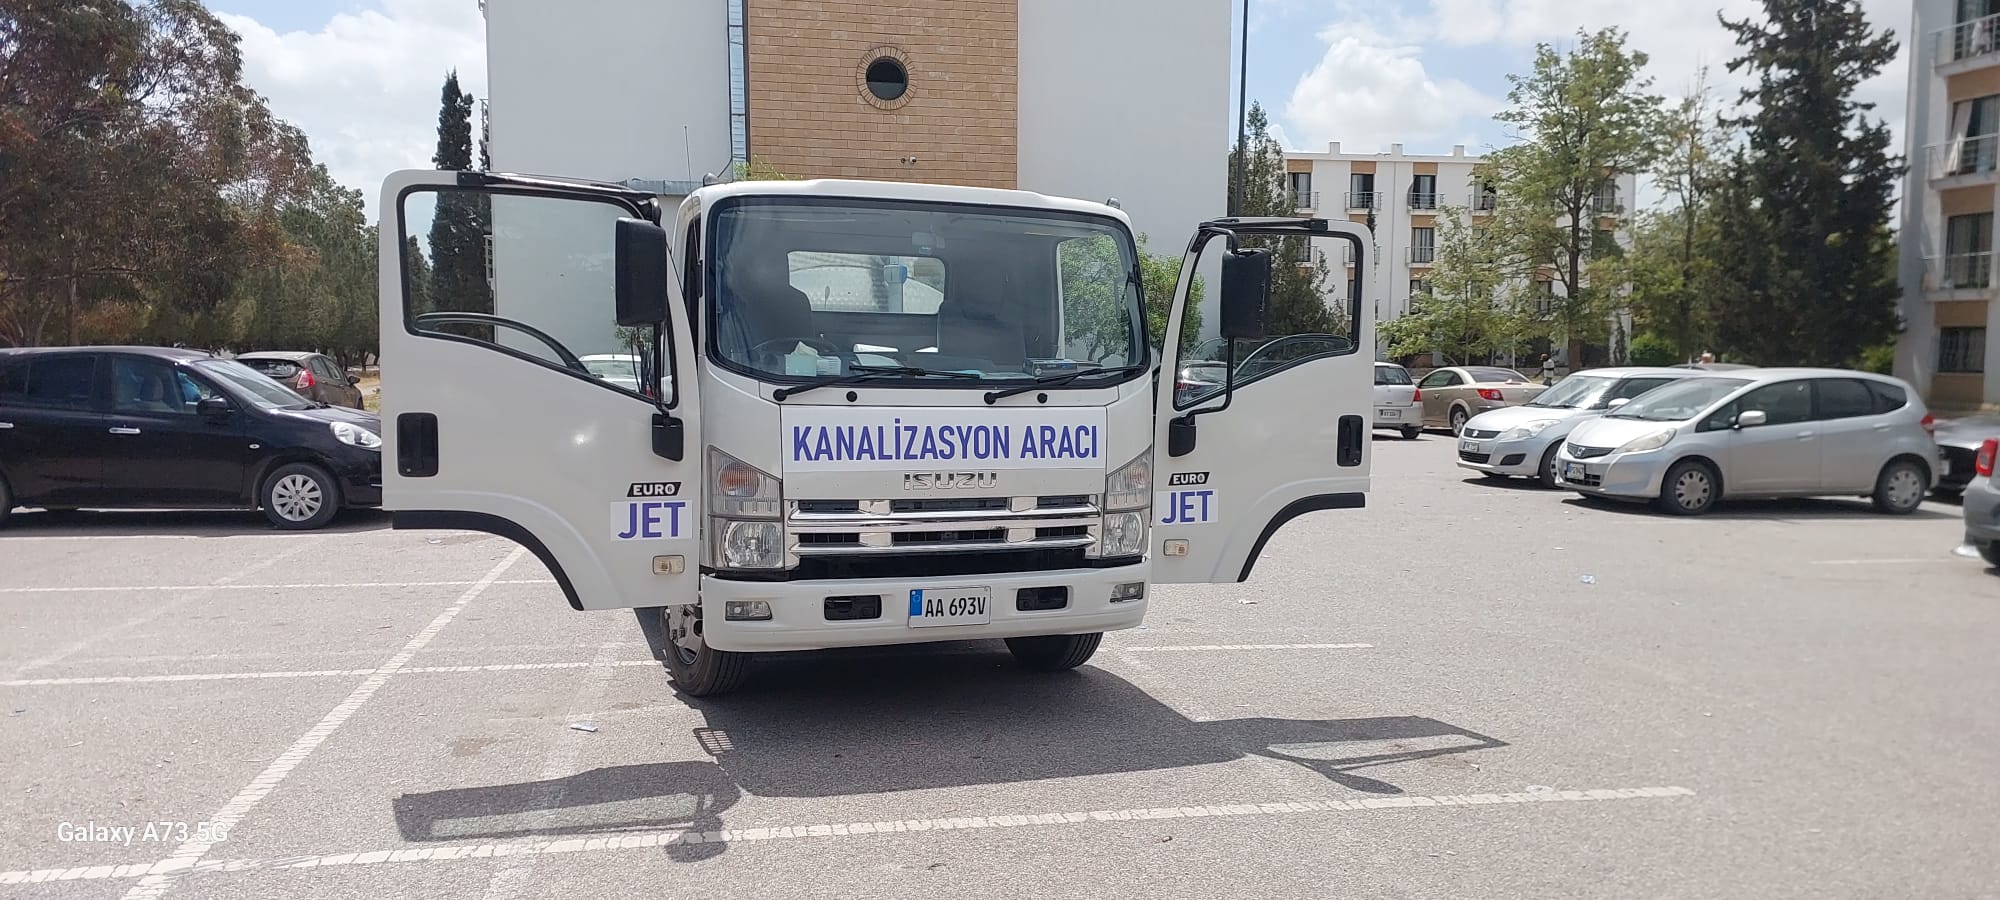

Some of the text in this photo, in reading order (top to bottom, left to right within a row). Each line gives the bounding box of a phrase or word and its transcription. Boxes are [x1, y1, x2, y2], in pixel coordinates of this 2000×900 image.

[793, 418, 1097, 461] KANALİZASYON ARACI
[903, 471, 997, 491] ISUZU
[1173, 473, 1205, 485] EURO
[618, 501, 686, 539] JET
[1161, 490, 1213, 523] JET
[925, 596, 986, 617] AA 693V
